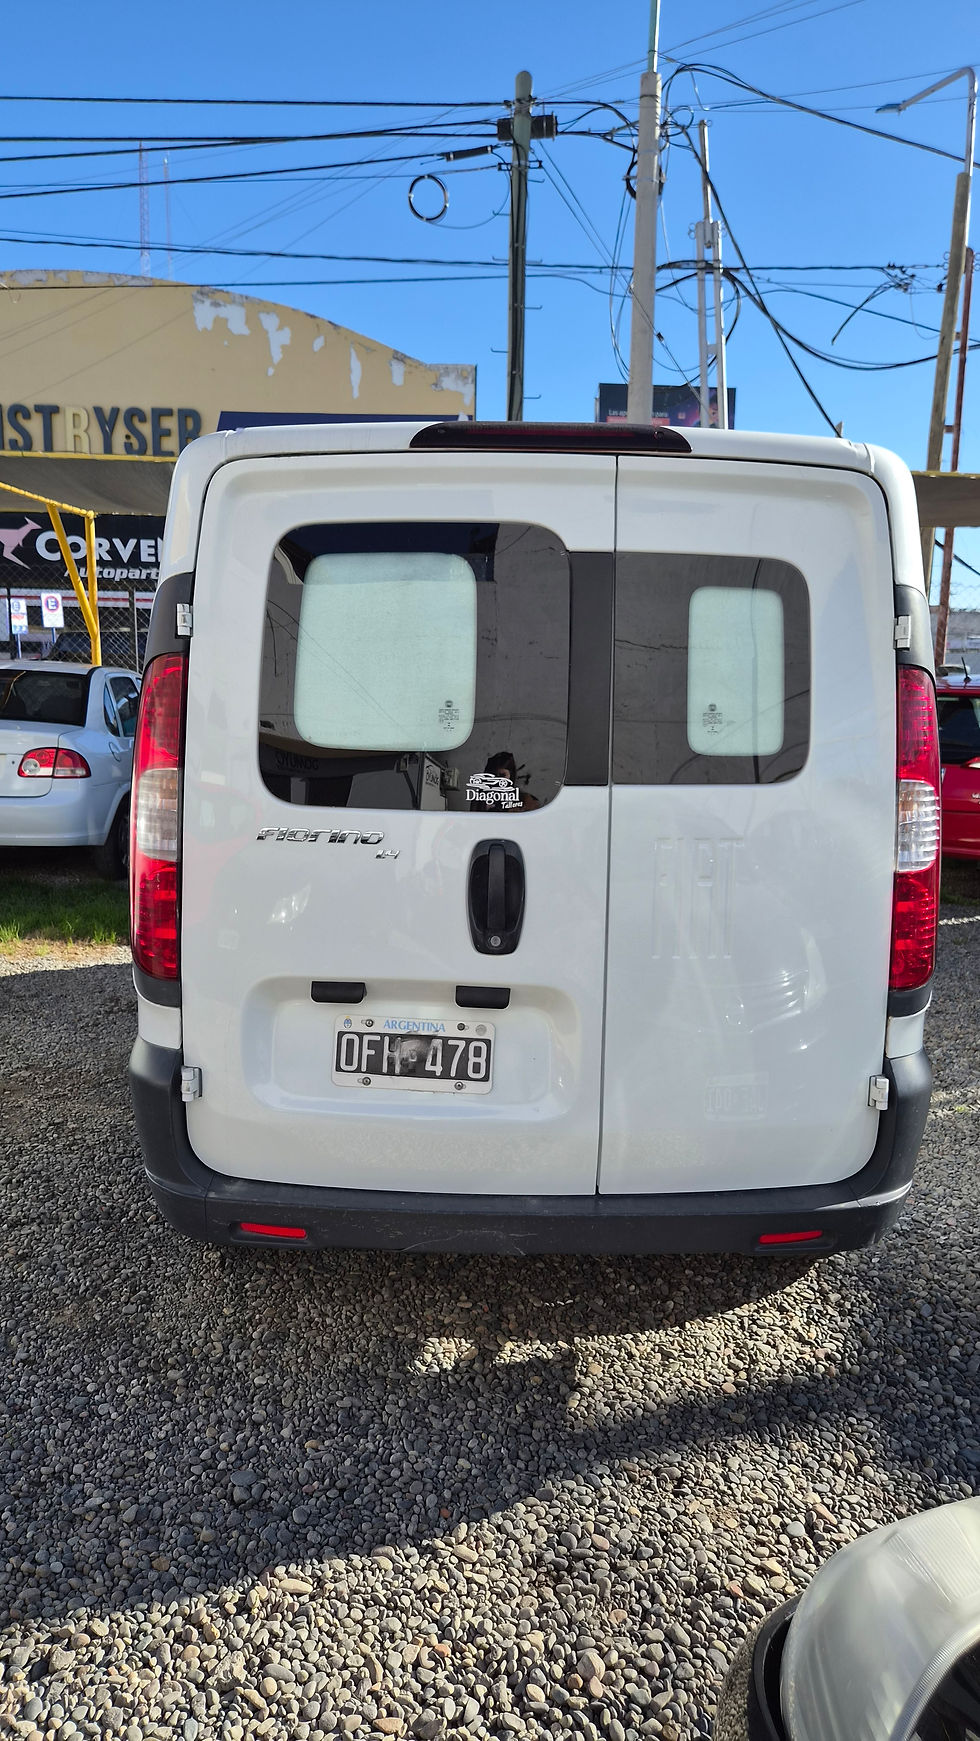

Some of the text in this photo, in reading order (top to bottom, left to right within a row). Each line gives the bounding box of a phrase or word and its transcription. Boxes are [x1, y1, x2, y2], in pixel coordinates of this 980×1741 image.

[466, 787, 520, 805] Diagonal
[383, 1019, 446, 1033] ARGENTINA
[340, 1033, 488, 1079] OFH 478
